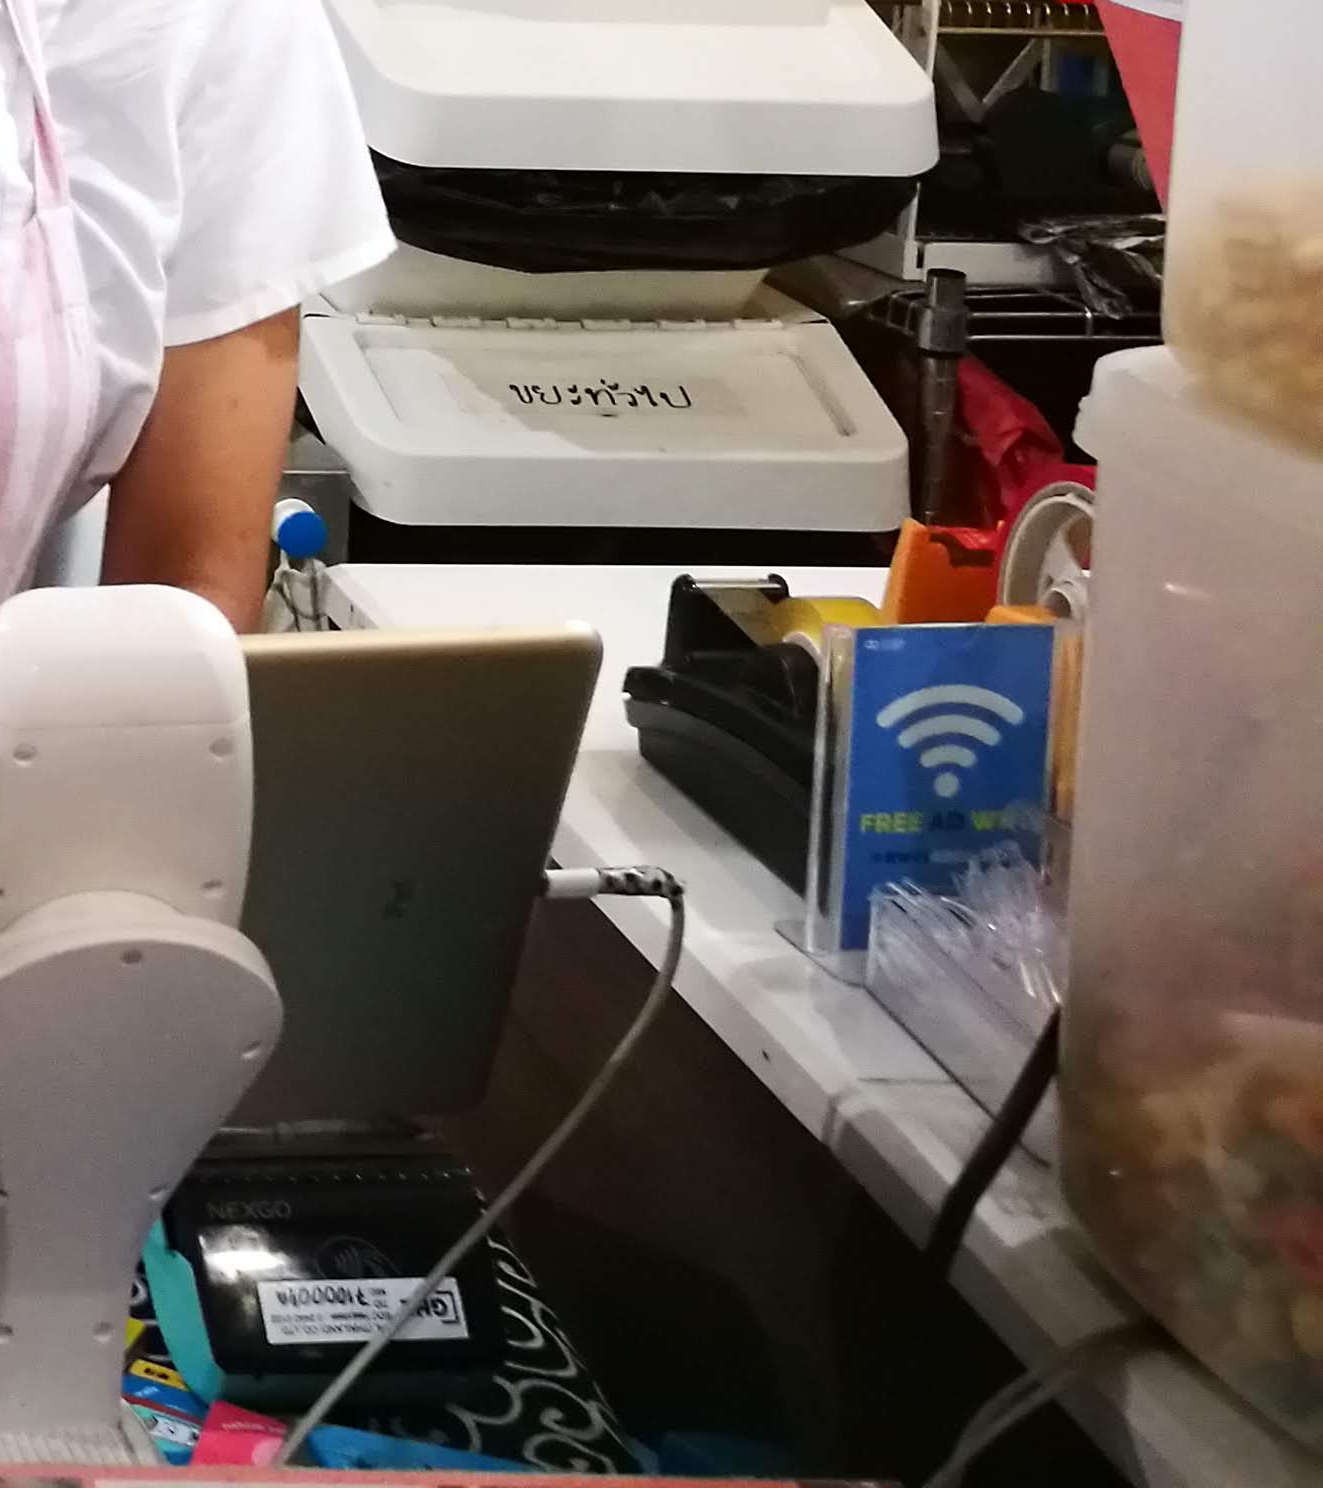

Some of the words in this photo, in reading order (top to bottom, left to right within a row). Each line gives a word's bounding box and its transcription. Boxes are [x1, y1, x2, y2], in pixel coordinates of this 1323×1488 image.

[508, 378, 693, 409] ขยะทั่วไป
[859, 811, 923, 833] FREE
[207, 1200, 293, 1220] NEXGO
